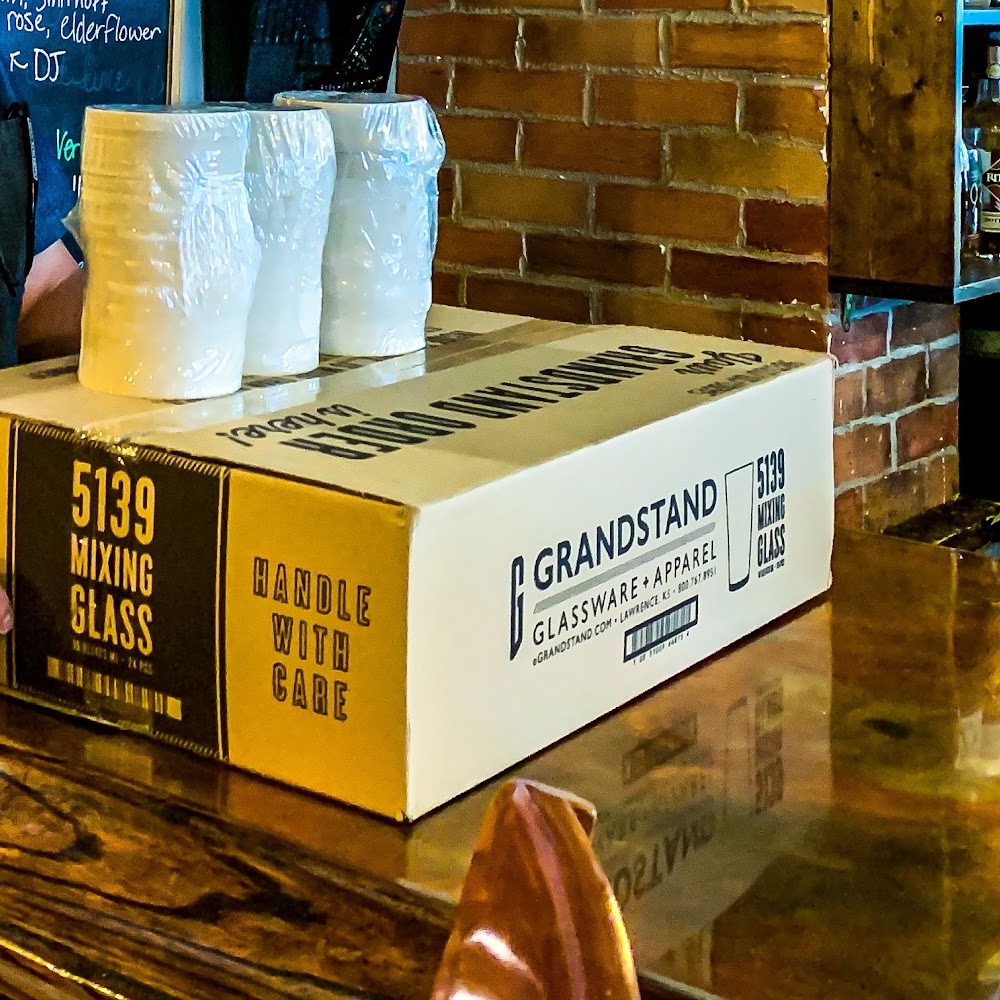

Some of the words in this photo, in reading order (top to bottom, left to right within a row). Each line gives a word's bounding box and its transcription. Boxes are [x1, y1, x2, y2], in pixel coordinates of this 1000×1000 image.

[60, 11, 161, 44] elderflower
[34, 48, 66, 82] DJ
[428, 345, 695, 419] GRANDSTAND
[278, 411, 477, 460] ORDER
[71, 459, 157, 547] 5139
[757, 448, 785, 499] 5139
[534, 478, 717, 590] GRANDSTAND
[758, 493, 785, 531] MIXING
[70, 533, 155, 598] MIXING
[758, 523, 785, 567] GLASS
[71, 584, 155, 657] GLASS
[252, 556, 373, 628] HANDLE
[533, 576, 638, 645] GLASSWARE
[654, 541, 717, 588] APPAREL
[271, 612, 350, 674] WITH
[271, 662, 349, 722] CARE
